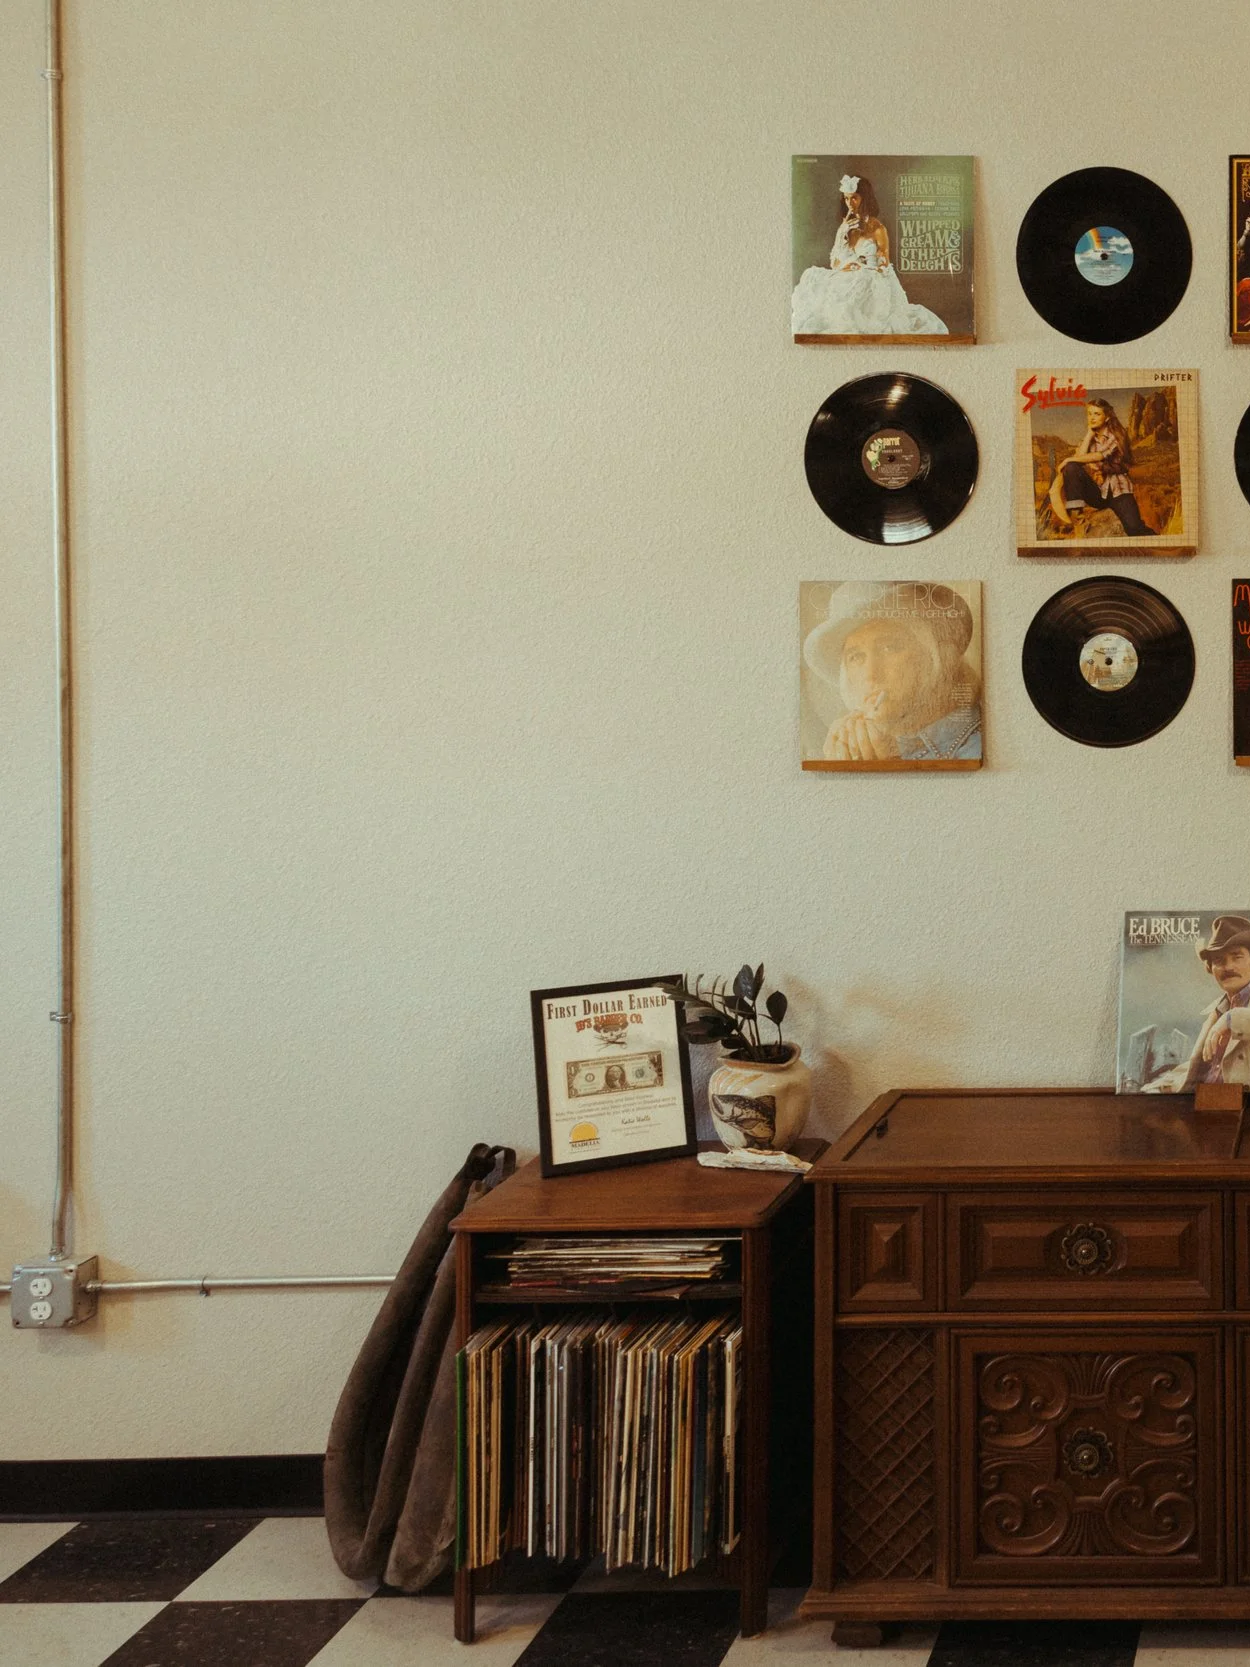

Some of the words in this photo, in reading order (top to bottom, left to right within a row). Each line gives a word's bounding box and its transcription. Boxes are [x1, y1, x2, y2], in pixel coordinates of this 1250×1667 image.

[900, 220, 961, 237] WHIPPED
[900, 229, 949, 248] CREAM
[900, 248, 960, 261] OTHER
[900, 251, 961, 271] DELIGHTS
[1154, 373, 1193, 382] DRIFTER
[1021, 375, 1088, 413] Sylvia
[914, 582, 971, 611] RICH
[1128, 918, 1148, 936] Ed
[1150, 917, 1201, 936] BRUCE
[1129, 934, 1144, 945] The
[546, 1003, 577, 1020] FIRST
[583, 999, 624, 1016] DOLLAR
[628, 994, 668, 1011] EARNED
